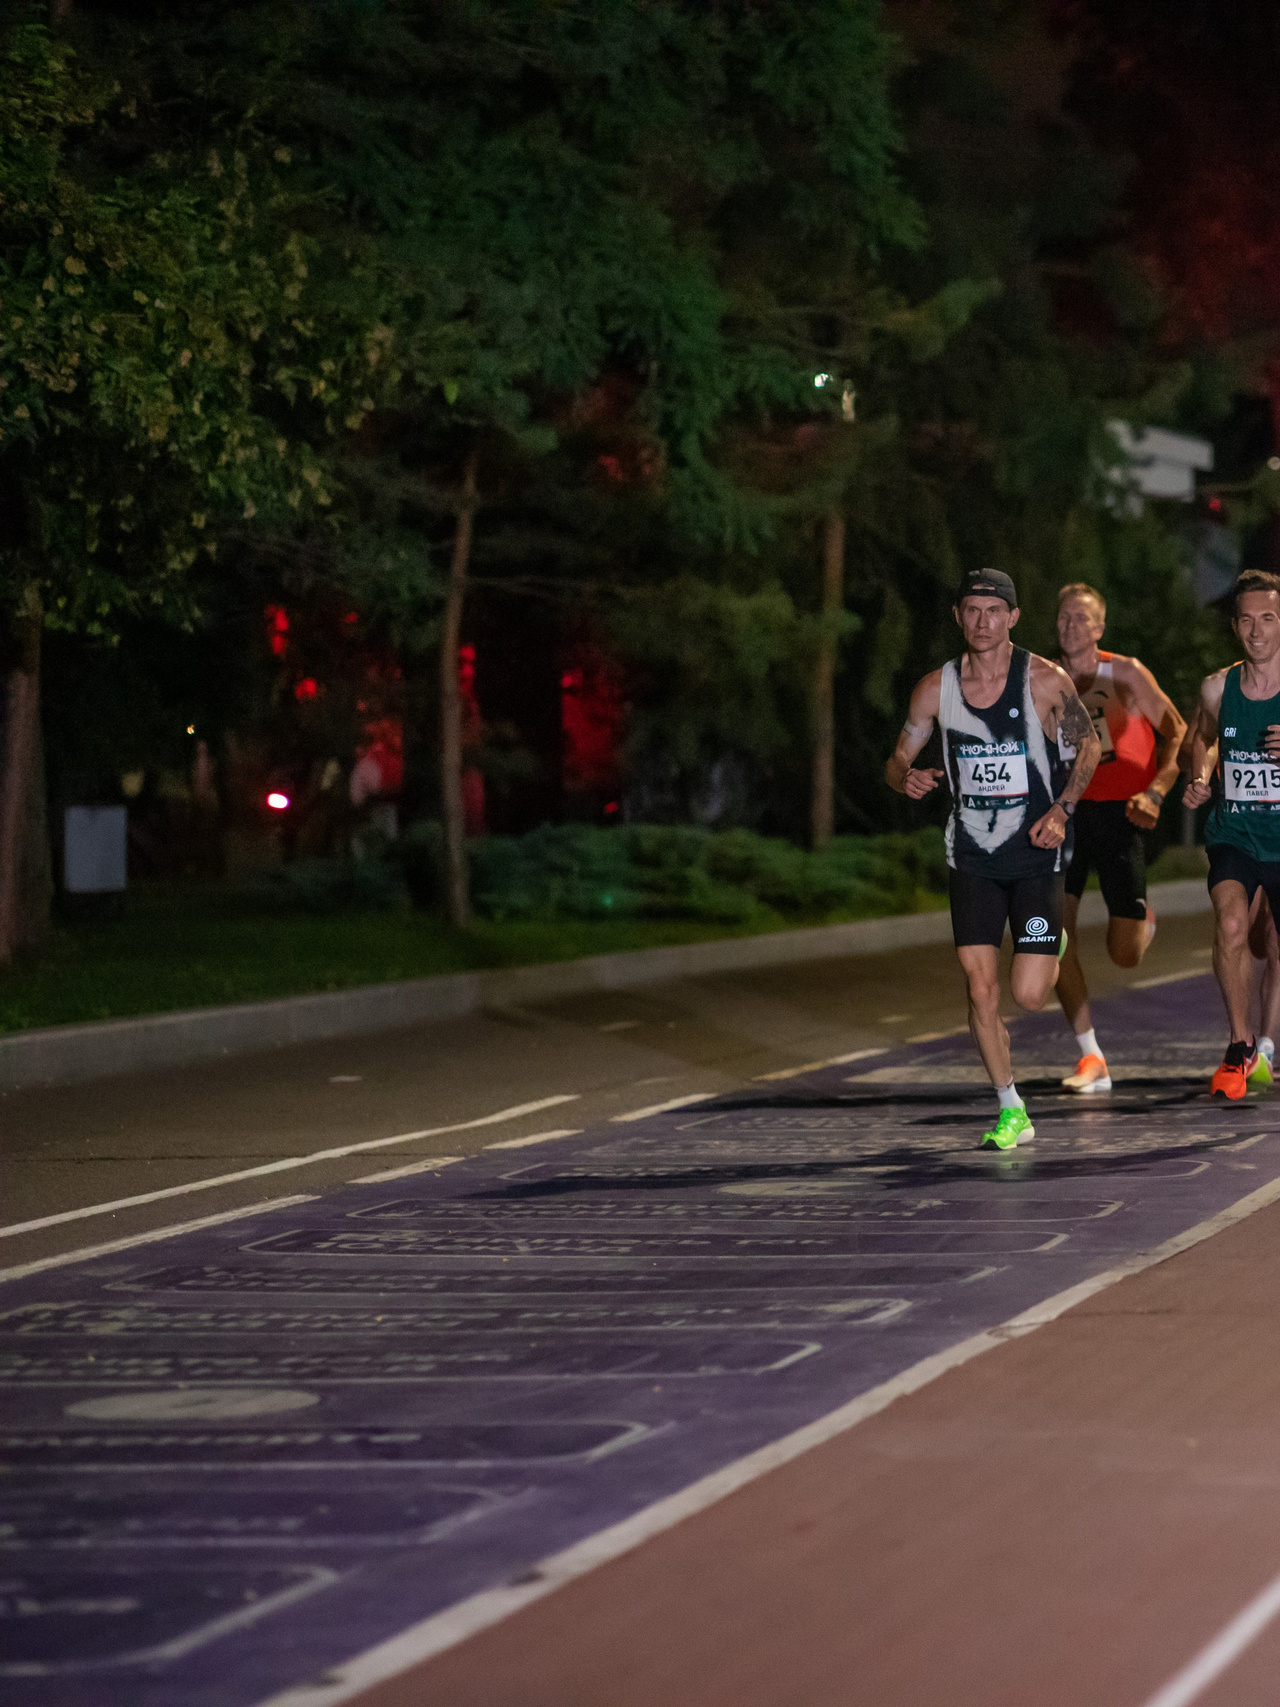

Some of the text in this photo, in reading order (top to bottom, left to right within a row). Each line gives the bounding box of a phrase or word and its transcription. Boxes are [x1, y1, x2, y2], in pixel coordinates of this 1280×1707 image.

[960, 741, 1019, 755] НОЧНОЙ
[971, 763, 1011, 783] 454
[978, 784, 1006, 792] АНДРЕЙ
[328, 1233, 711, 1245] Потянитесь
[392, 1244, 632, 1253] секунд
